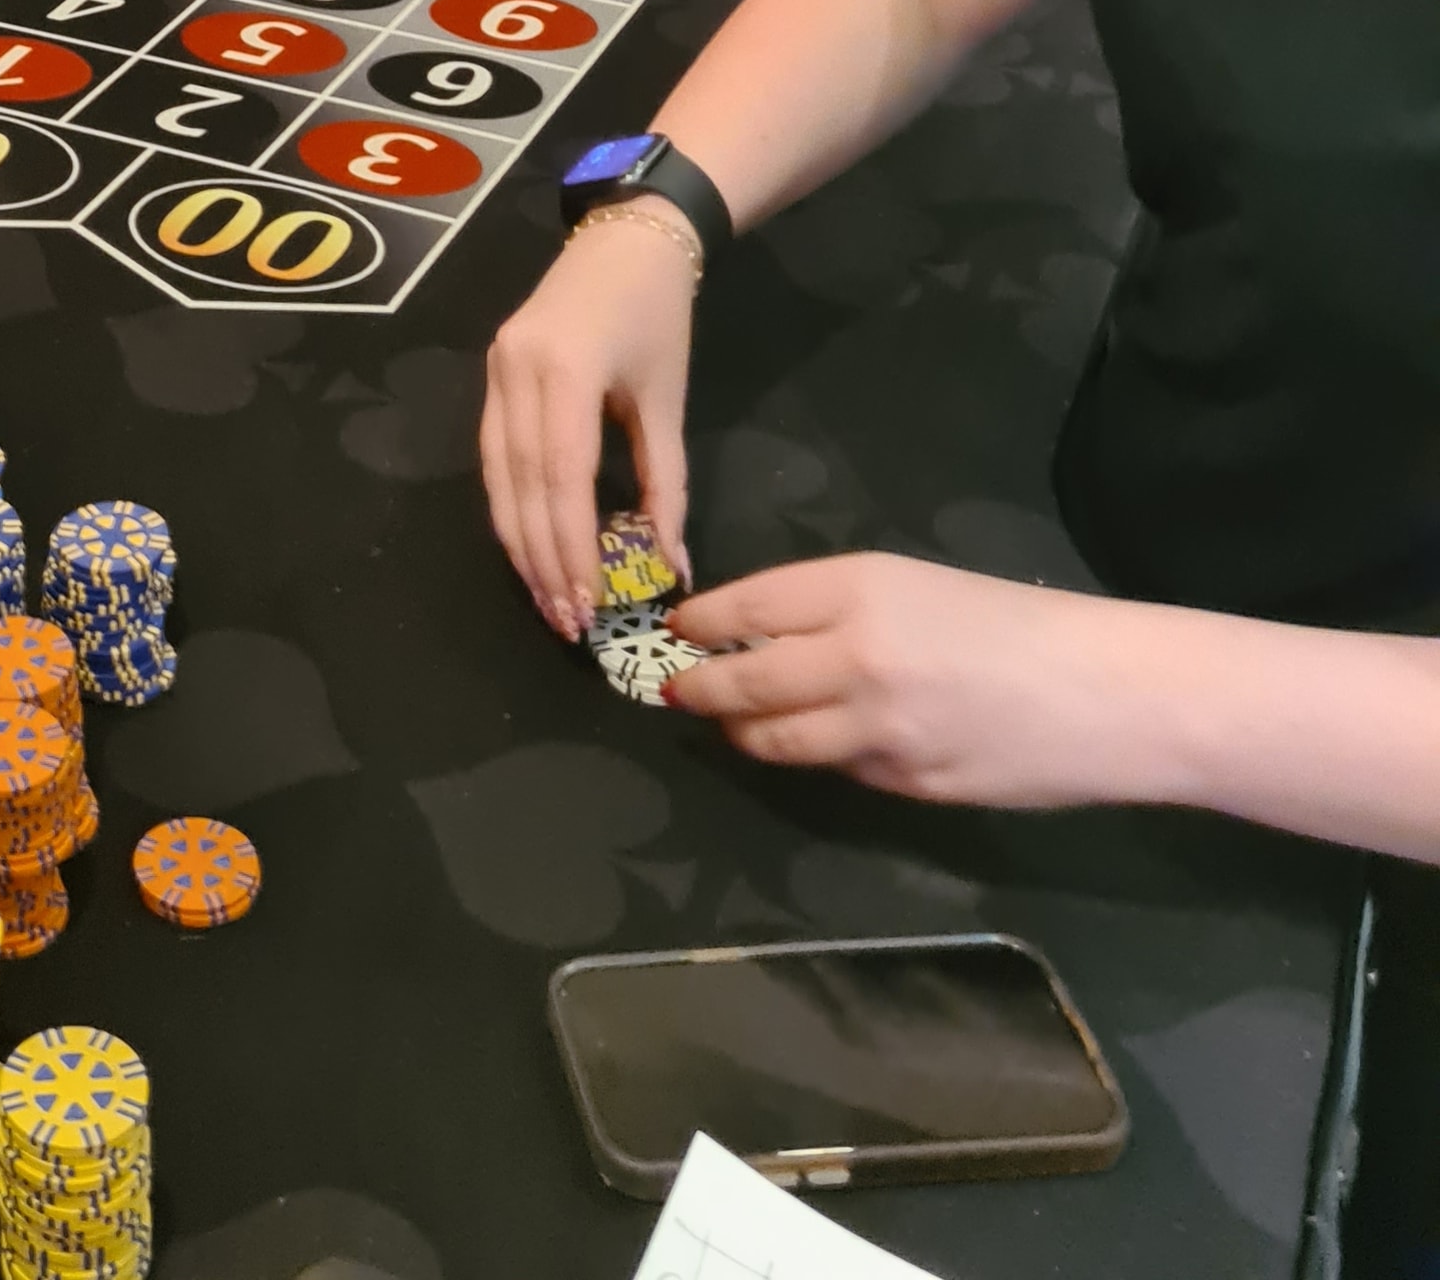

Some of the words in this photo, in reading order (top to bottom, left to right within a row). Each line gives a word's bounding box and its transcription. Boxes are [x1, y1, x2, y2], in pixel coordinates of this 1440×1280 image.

[220, 20, 310, 67] 5
[153, 82, 246, 139] 2
[409, 59, 495, 107] 6
[346, 130, 440, 187] 3
[157, 187, 354, 282] 00
